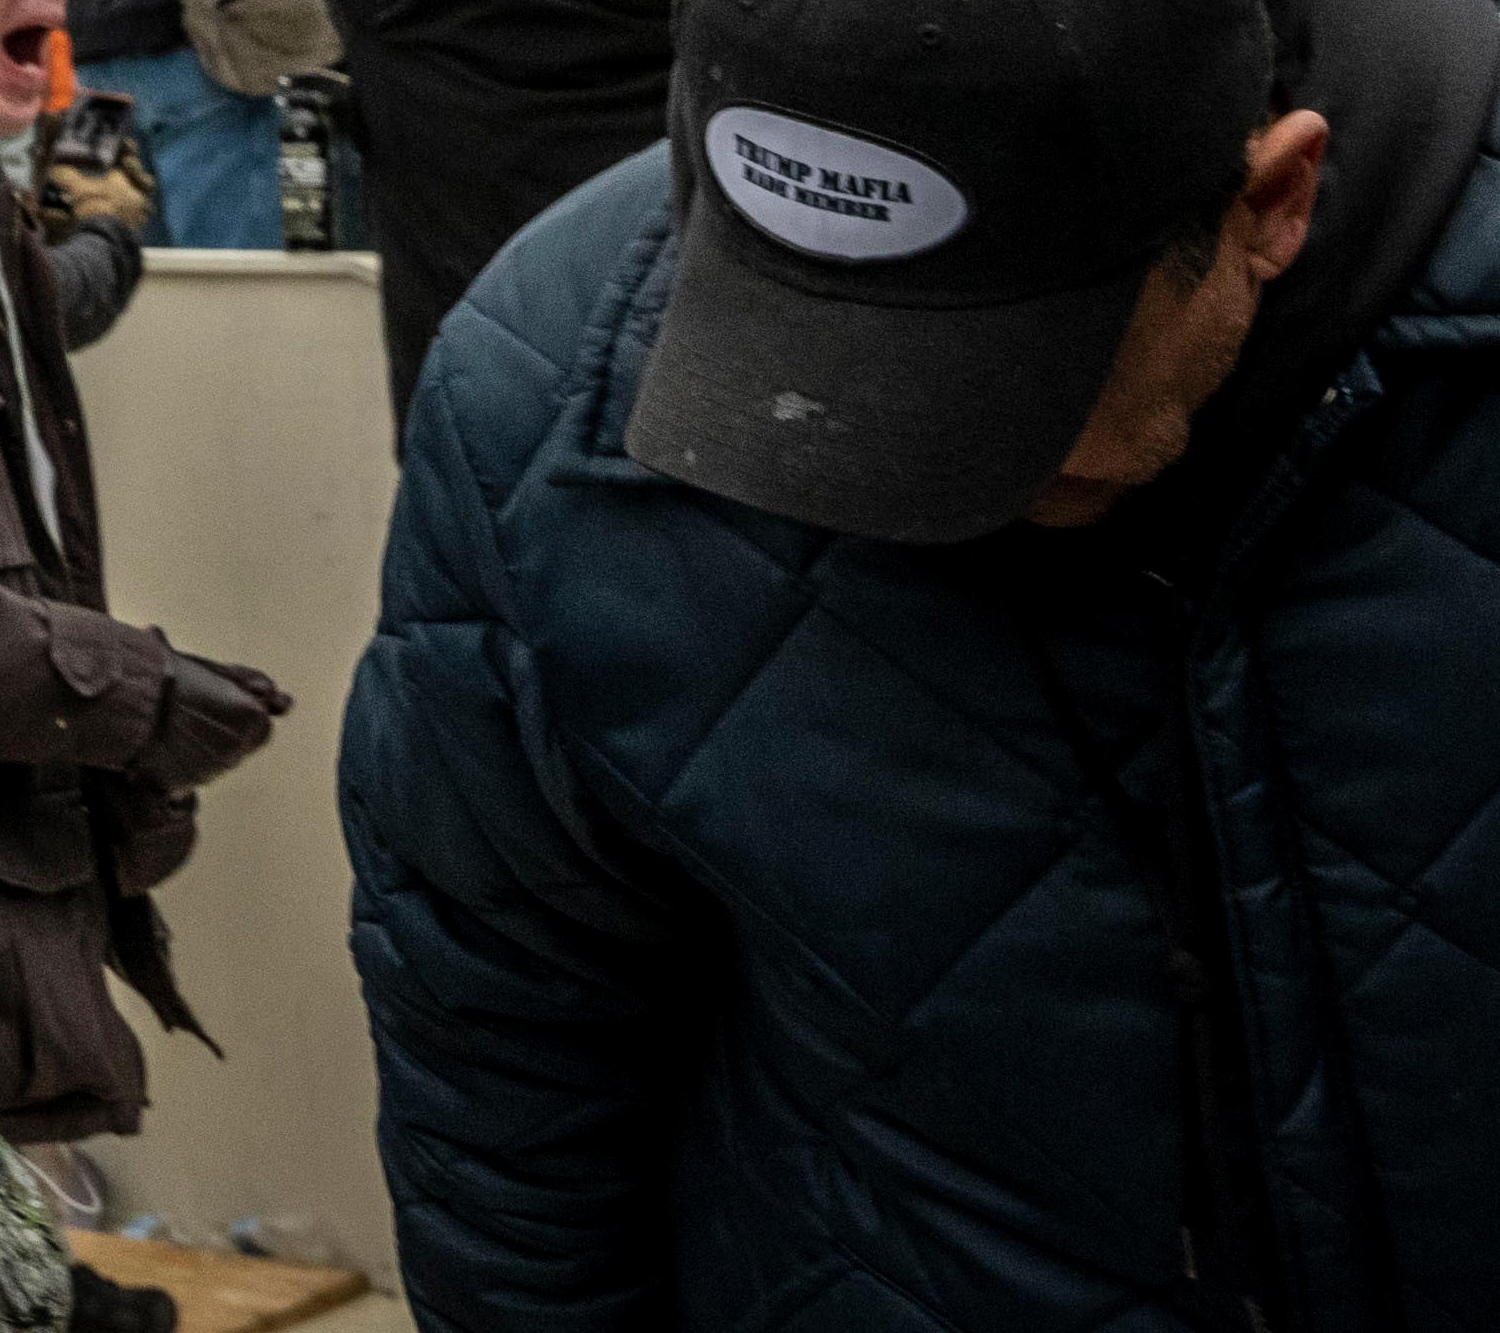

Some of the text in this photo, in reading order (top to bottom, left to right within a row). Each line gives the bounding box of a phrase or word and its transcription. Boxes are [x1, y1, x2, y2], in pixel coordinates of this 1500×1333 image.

[734, 133, 914, 204] TRUMP MAFIA
[794, 184, 892, 223] MEMBER
